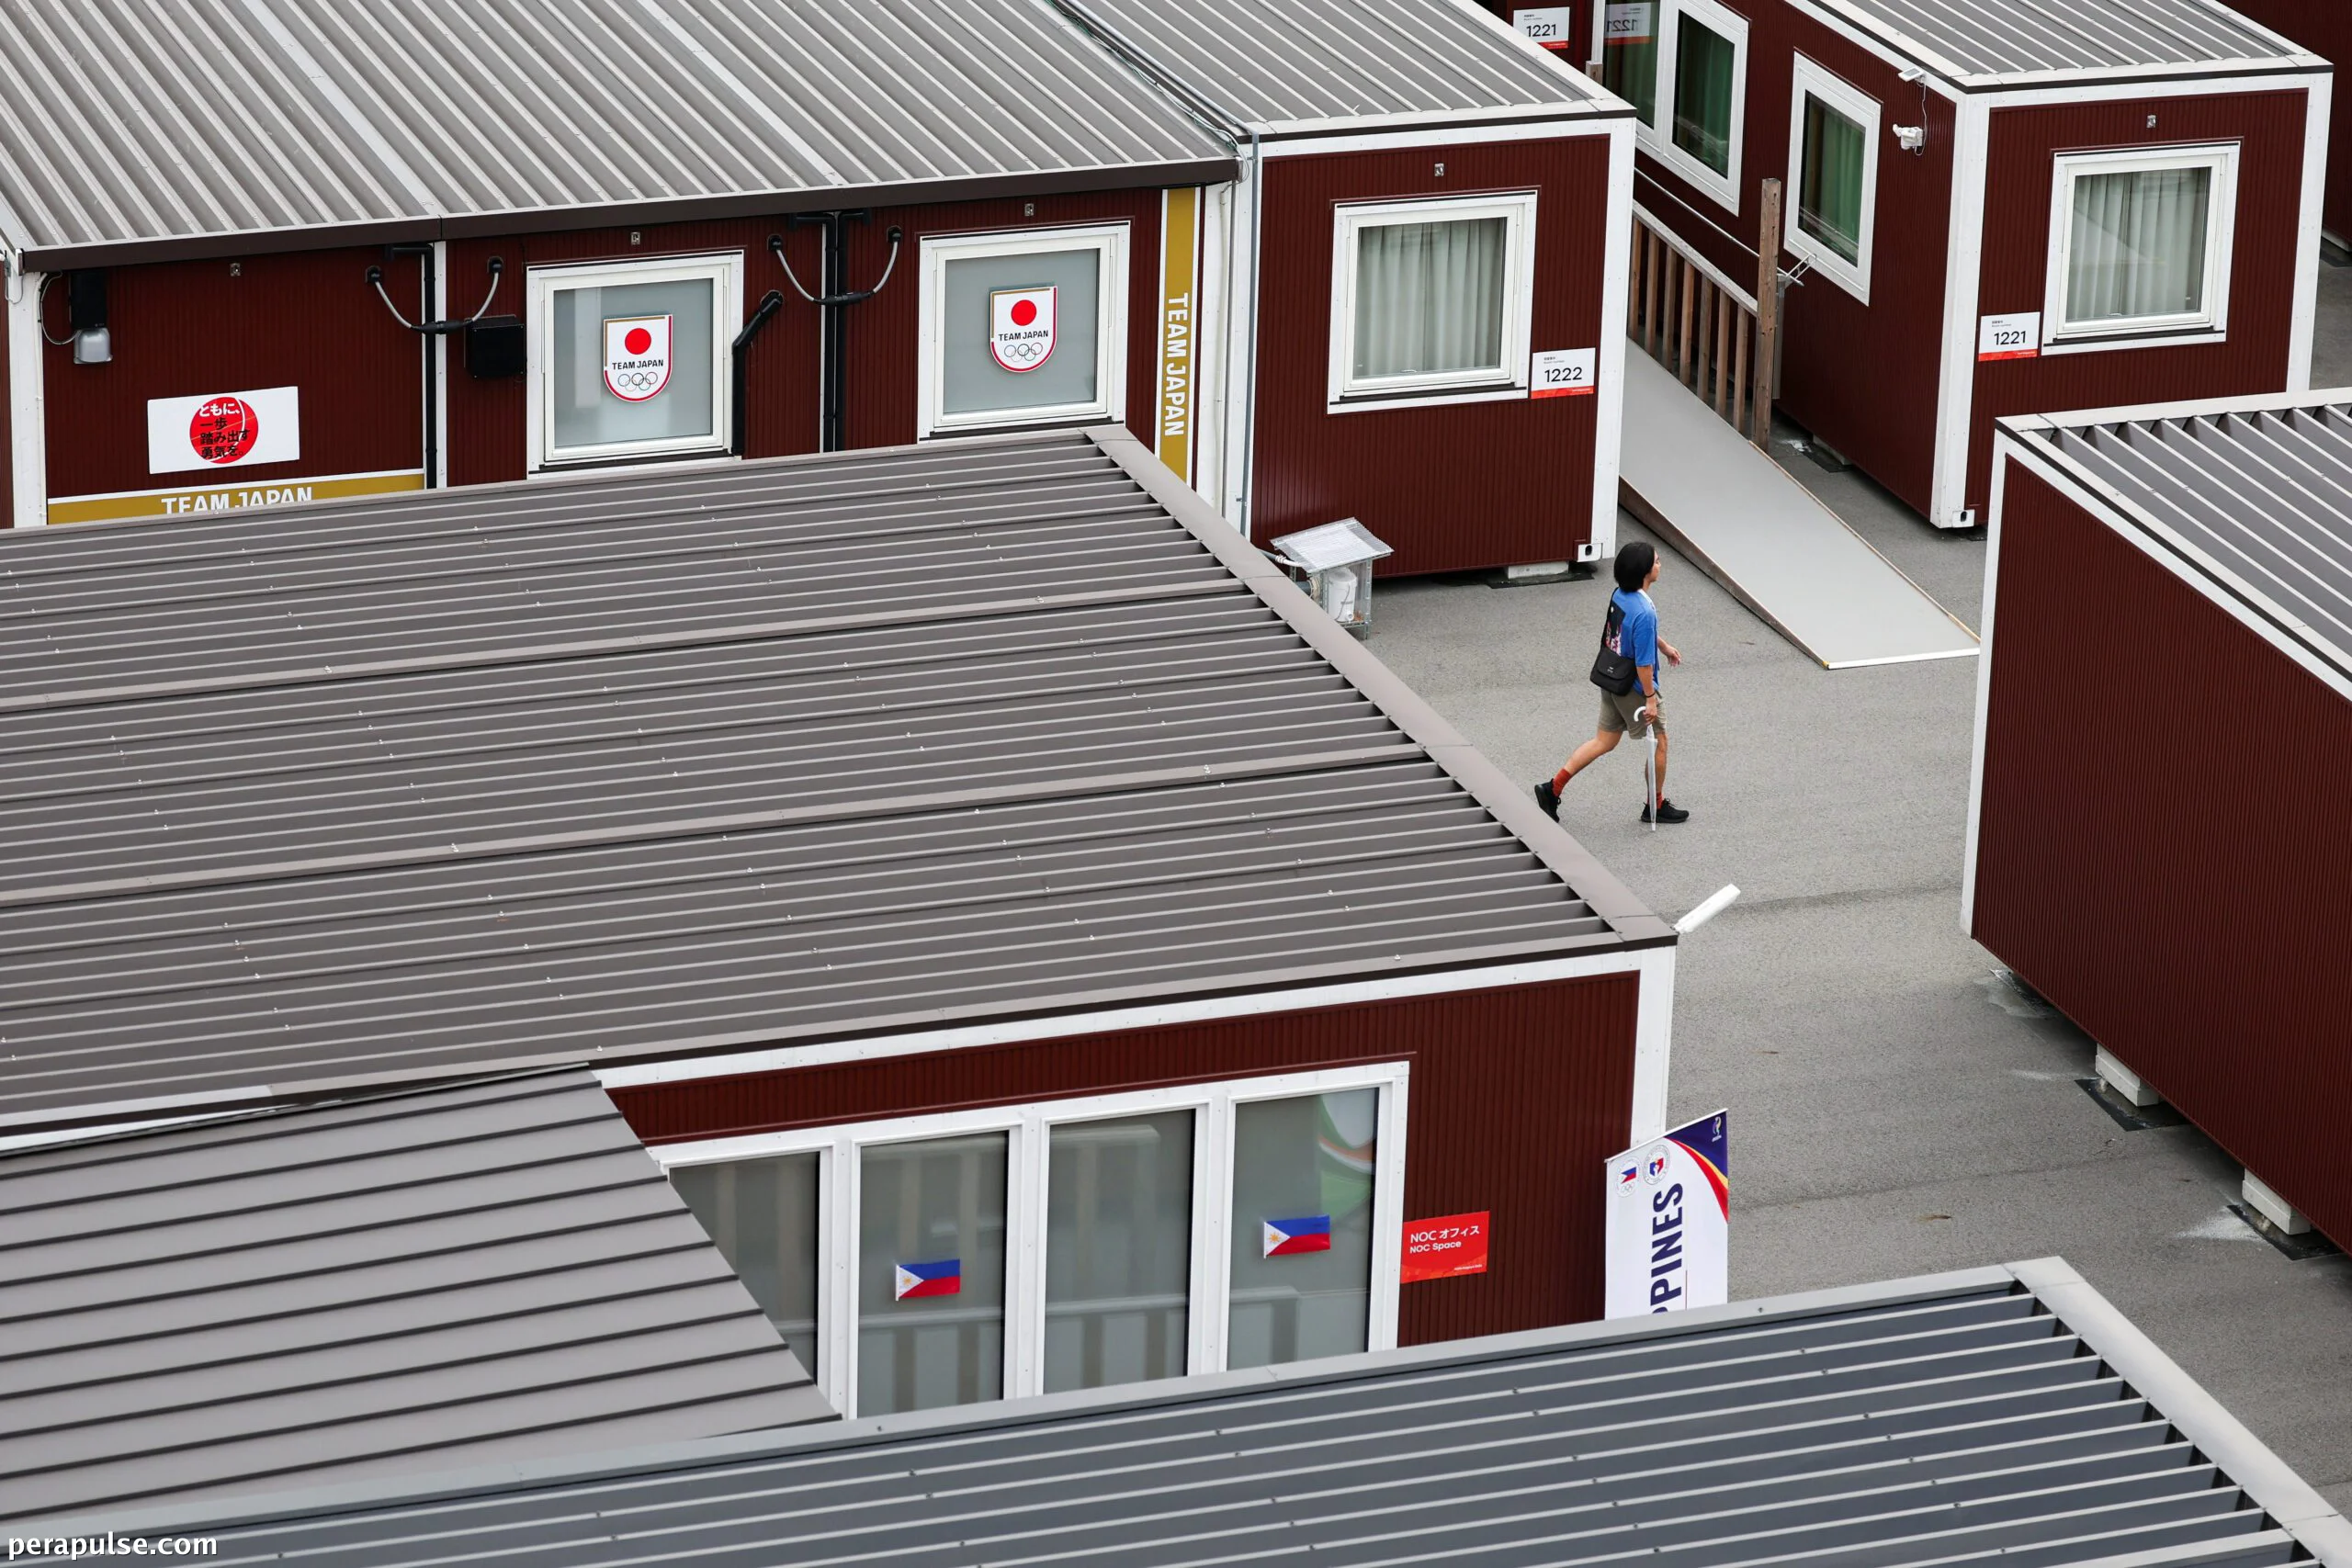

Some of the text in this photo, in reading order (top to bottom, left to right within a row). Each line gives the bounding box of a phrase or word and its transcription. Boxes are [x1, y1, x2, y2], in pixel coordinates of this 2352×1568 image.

[1526, 24, 1556, 38] 1221
[999, 330, 1049, 342] TEAM JAPAN
[1994, 331, 2027, 345] 1221
[612, 359, 664, 370] TEAM JAPAN
[1164, 292, 1189, 436] TEAM JAPAN
[1544, 367, 1583, 383] 1222
[161, 487, 312, 515] TEAM JAPAN
[1410, 1225, 1480, 1244] NOC オフィス
[1409, 1241, 1462, 1254] NOC Space
[1650, 1182, 1684, 1314] PINES
